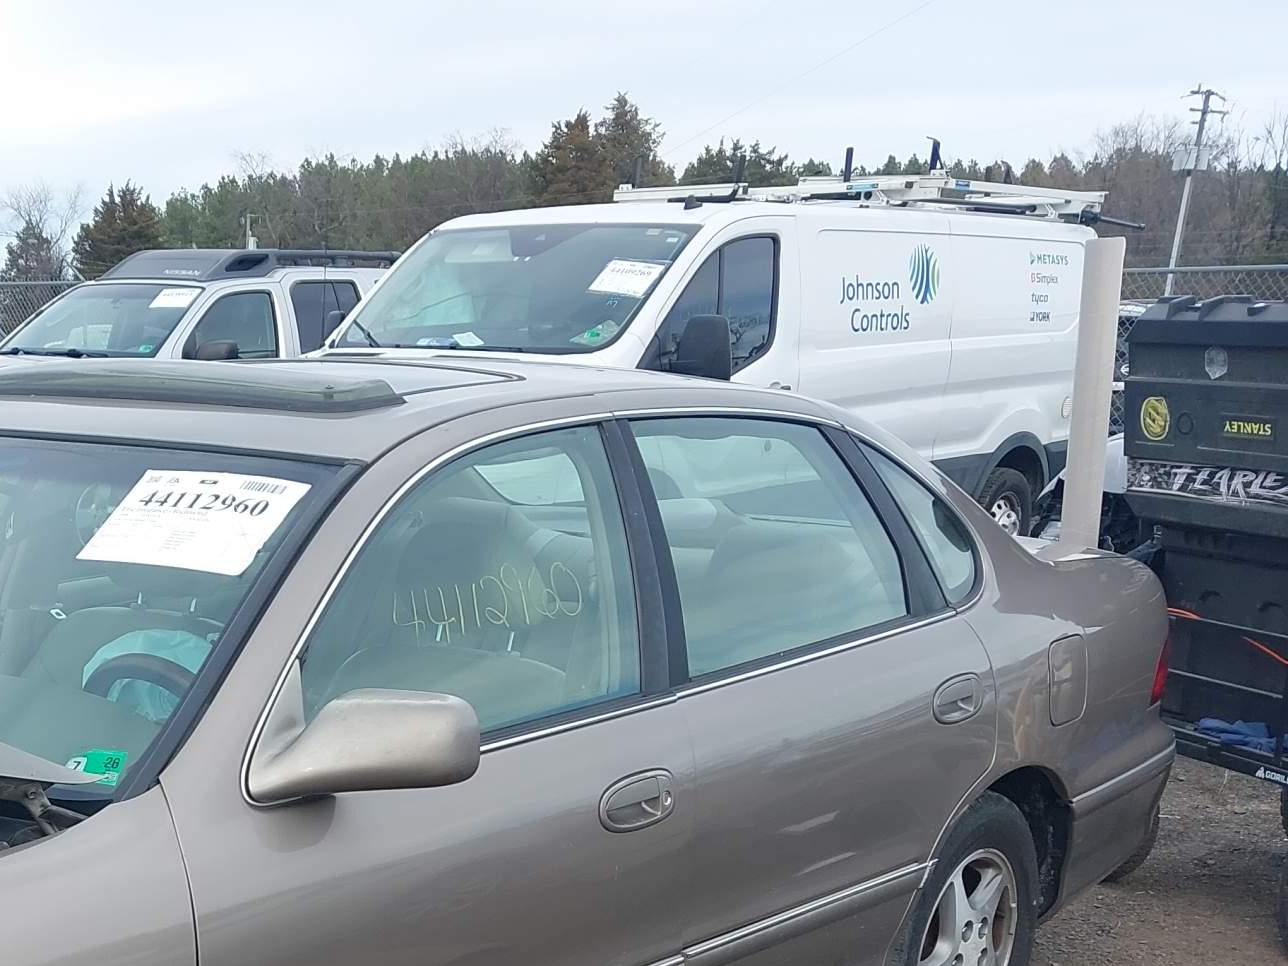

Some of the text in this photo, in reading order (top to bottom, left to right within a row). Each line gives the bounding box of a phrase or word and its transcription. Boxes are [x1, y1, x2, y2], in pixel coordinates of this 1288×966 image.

[1036, 253, 1069, 266] METASYS
[840, 276, 899, 304] Johnson
[1031, 292, 1049, 304] tyco
[850, 306, 910, 332] Controls
[1035, 311, 1050, 322] YORK
[1224, 421, 1271, 435] STANLEY
[139, 490, 269, 516] 44112960
[392, 561, 582, 644] 44112960
